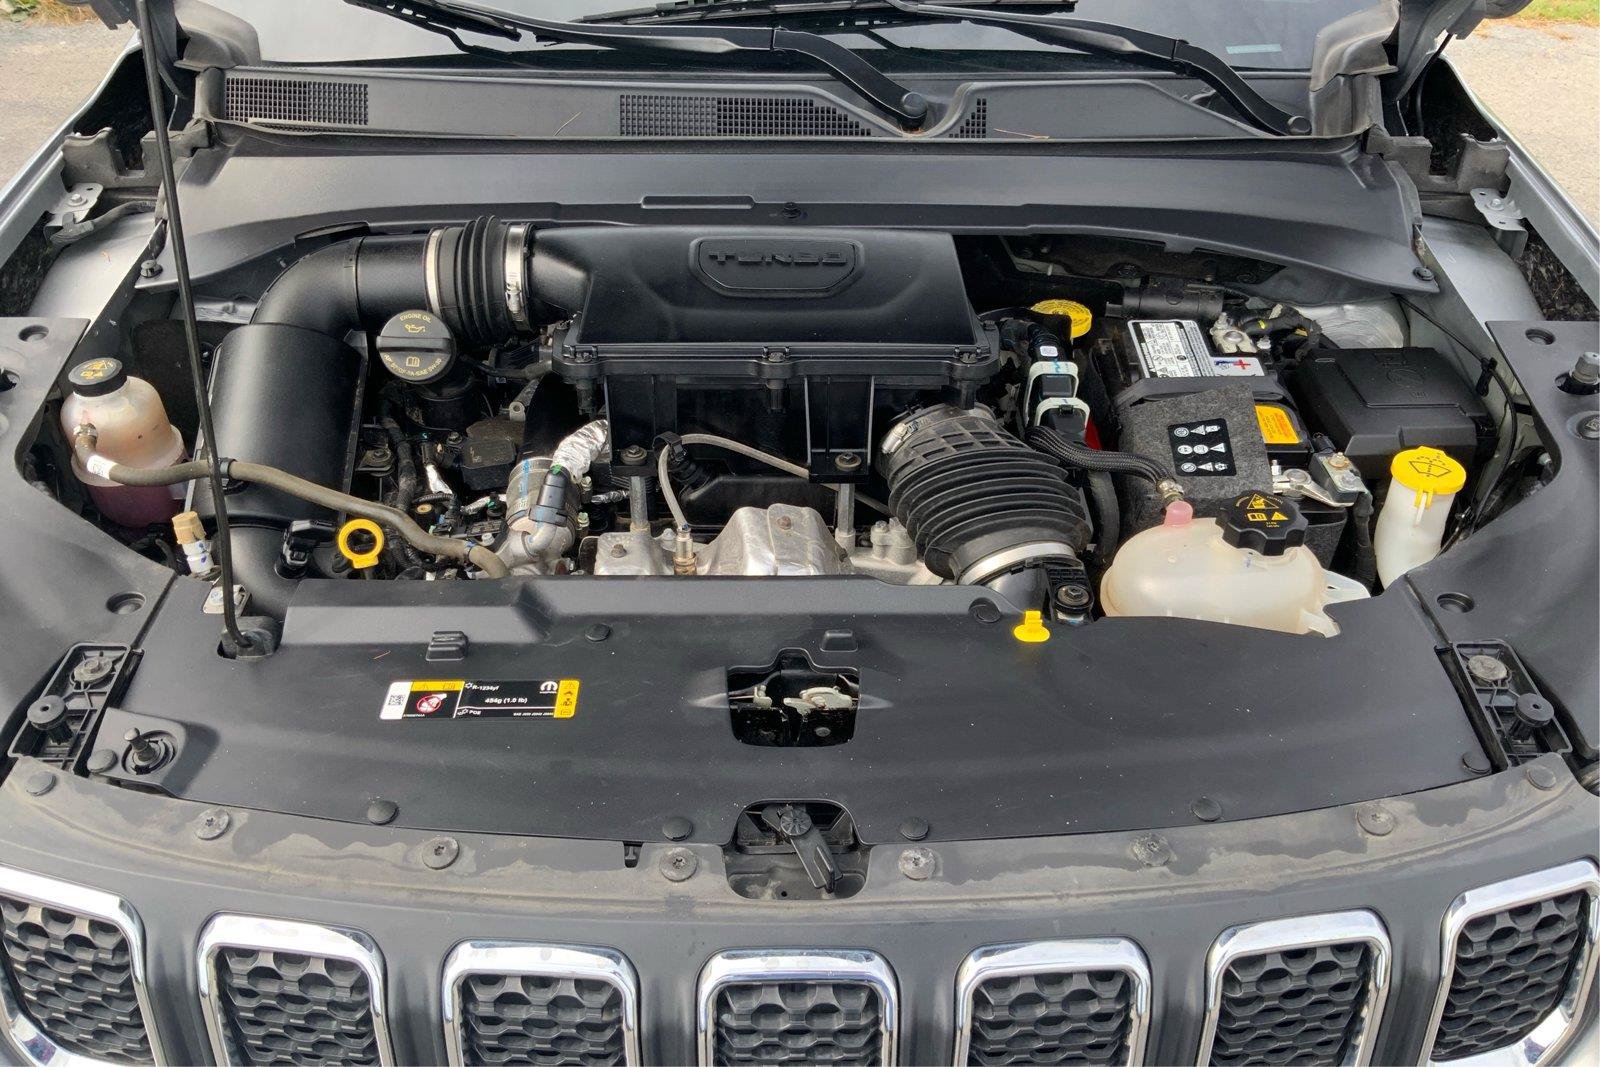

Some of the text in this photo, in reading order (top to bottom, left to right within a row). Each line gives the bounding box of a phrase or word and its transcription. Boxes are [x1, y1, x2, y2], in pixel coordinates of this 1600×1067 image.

[400, 313, 432, 324] ENGINE OIL
[472, 684, 500, 692] R-1234yf
